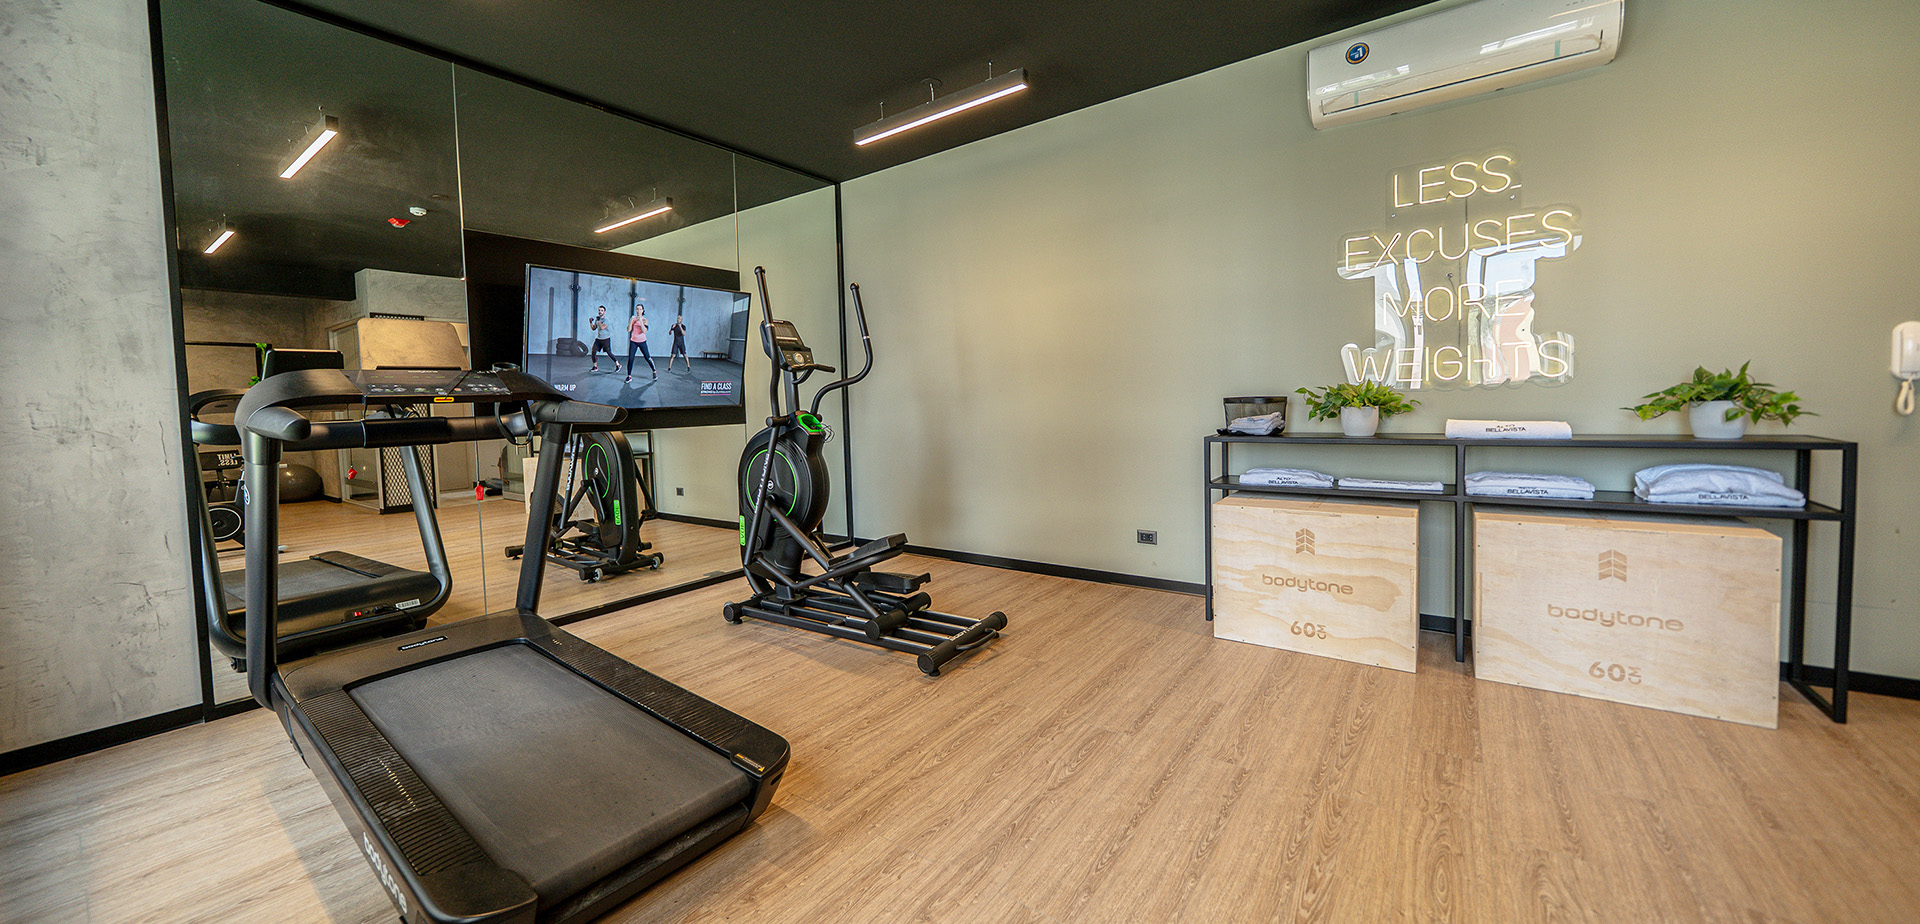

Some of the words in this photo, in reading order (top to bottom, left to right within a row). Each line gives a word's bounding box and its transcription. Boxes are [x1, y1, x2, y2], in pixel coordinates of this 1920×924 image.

[1393, 155, 1512, 208] LESS
[1345, 210, 1573, 271] EXCUSES
[1383, 279, 1526, 326] MORE
[1349, 339, 1569, 382] WEIGHTS
[701, 382, 712, 391] FIND
[713, 382, 717, 391] A
[717, 382, 732, 390] CLASS
[1261, 573, 1354, 595] bodytone
[1547, 603, 1685, 632] bodytone
[363, 832, 407, 913] bodytone
